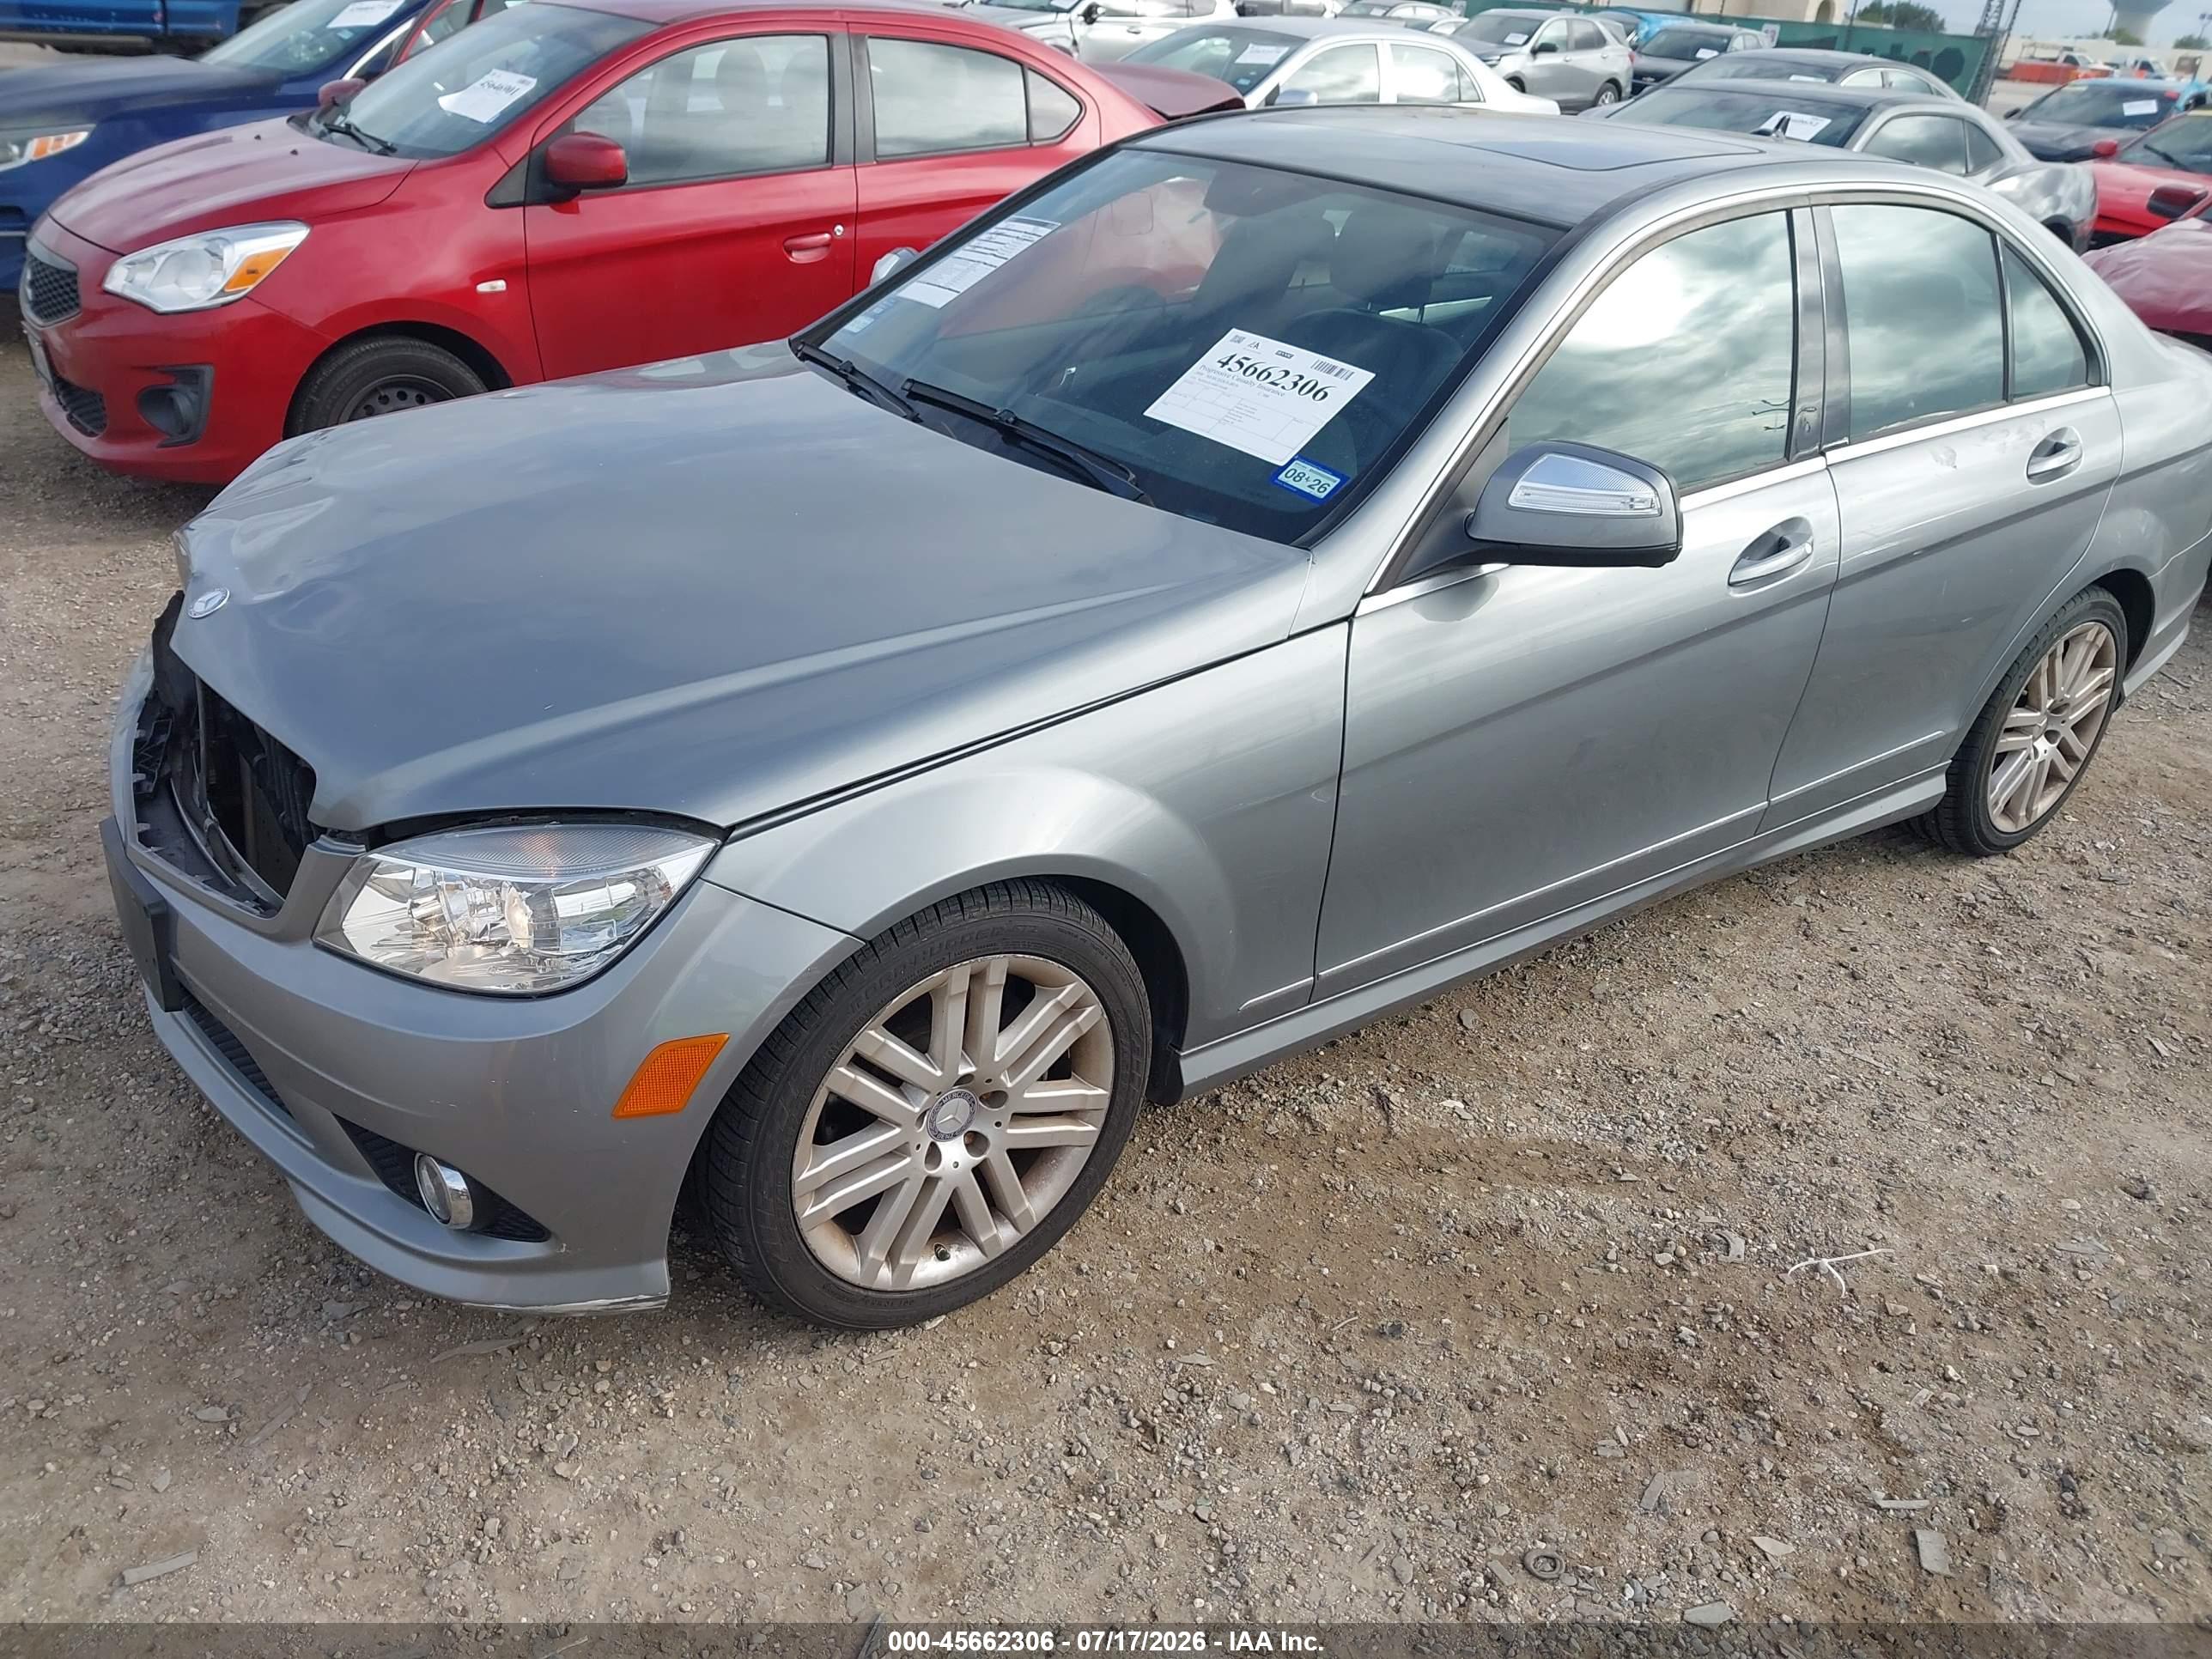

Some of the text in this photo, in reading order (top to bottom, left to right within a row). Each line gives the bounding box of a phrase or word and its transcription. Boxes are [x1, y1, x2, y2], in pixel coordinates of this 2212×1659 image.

[1217, 353, 1338, 402] 45662306
[1284, 468, 1306, 483] 08
[1307, 478, 1331, 494] 26
[942, 1091, 975, 1104] MERCEDES
